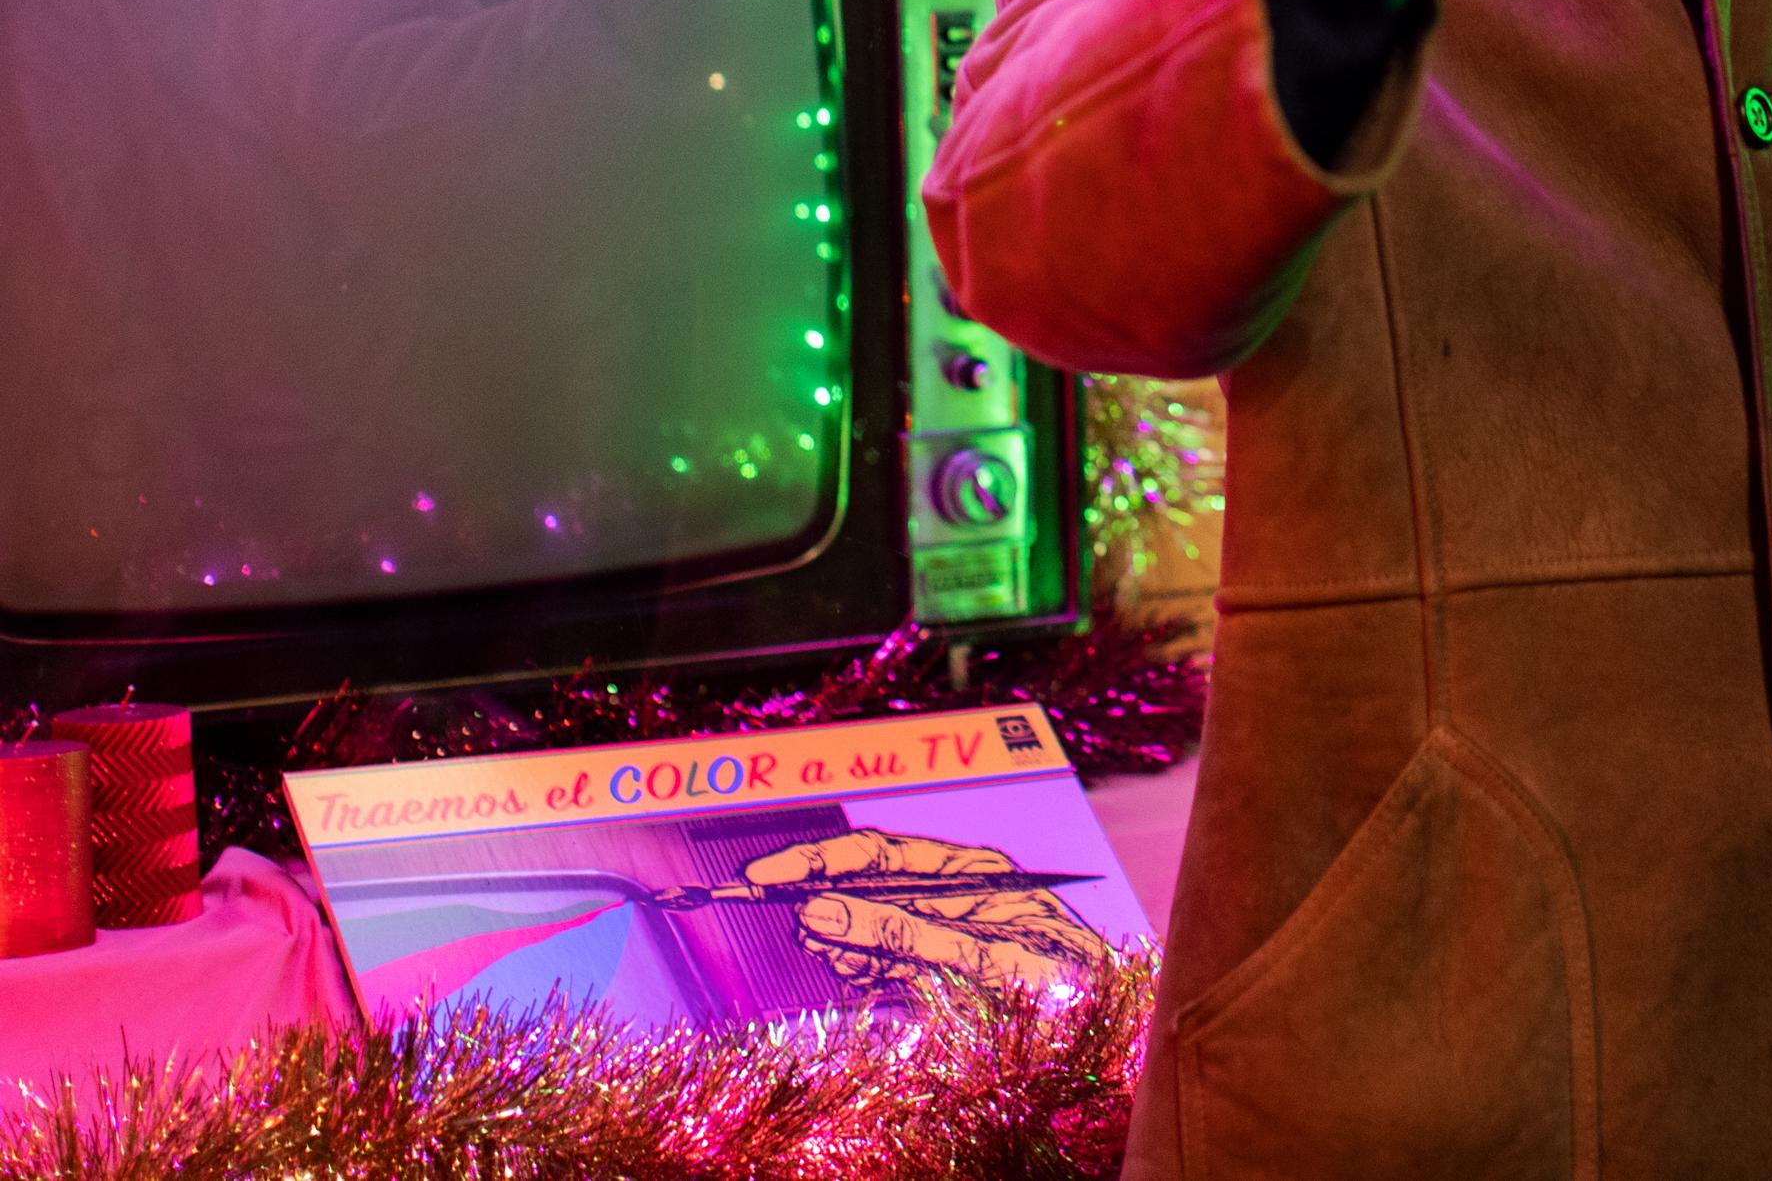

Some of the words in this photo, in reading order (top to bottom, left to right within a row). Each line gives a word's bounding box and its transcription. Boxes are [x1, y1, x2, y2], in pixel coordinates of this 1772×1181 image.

[315, 786, 528, 833] Traemos
[545, 771, 593, 811] el
[609, 753, 777, 804] COLOR
[801, 758, 832, 784] a
[849, 750, 907, 779] su
[919, 730, 984, 771] TV
